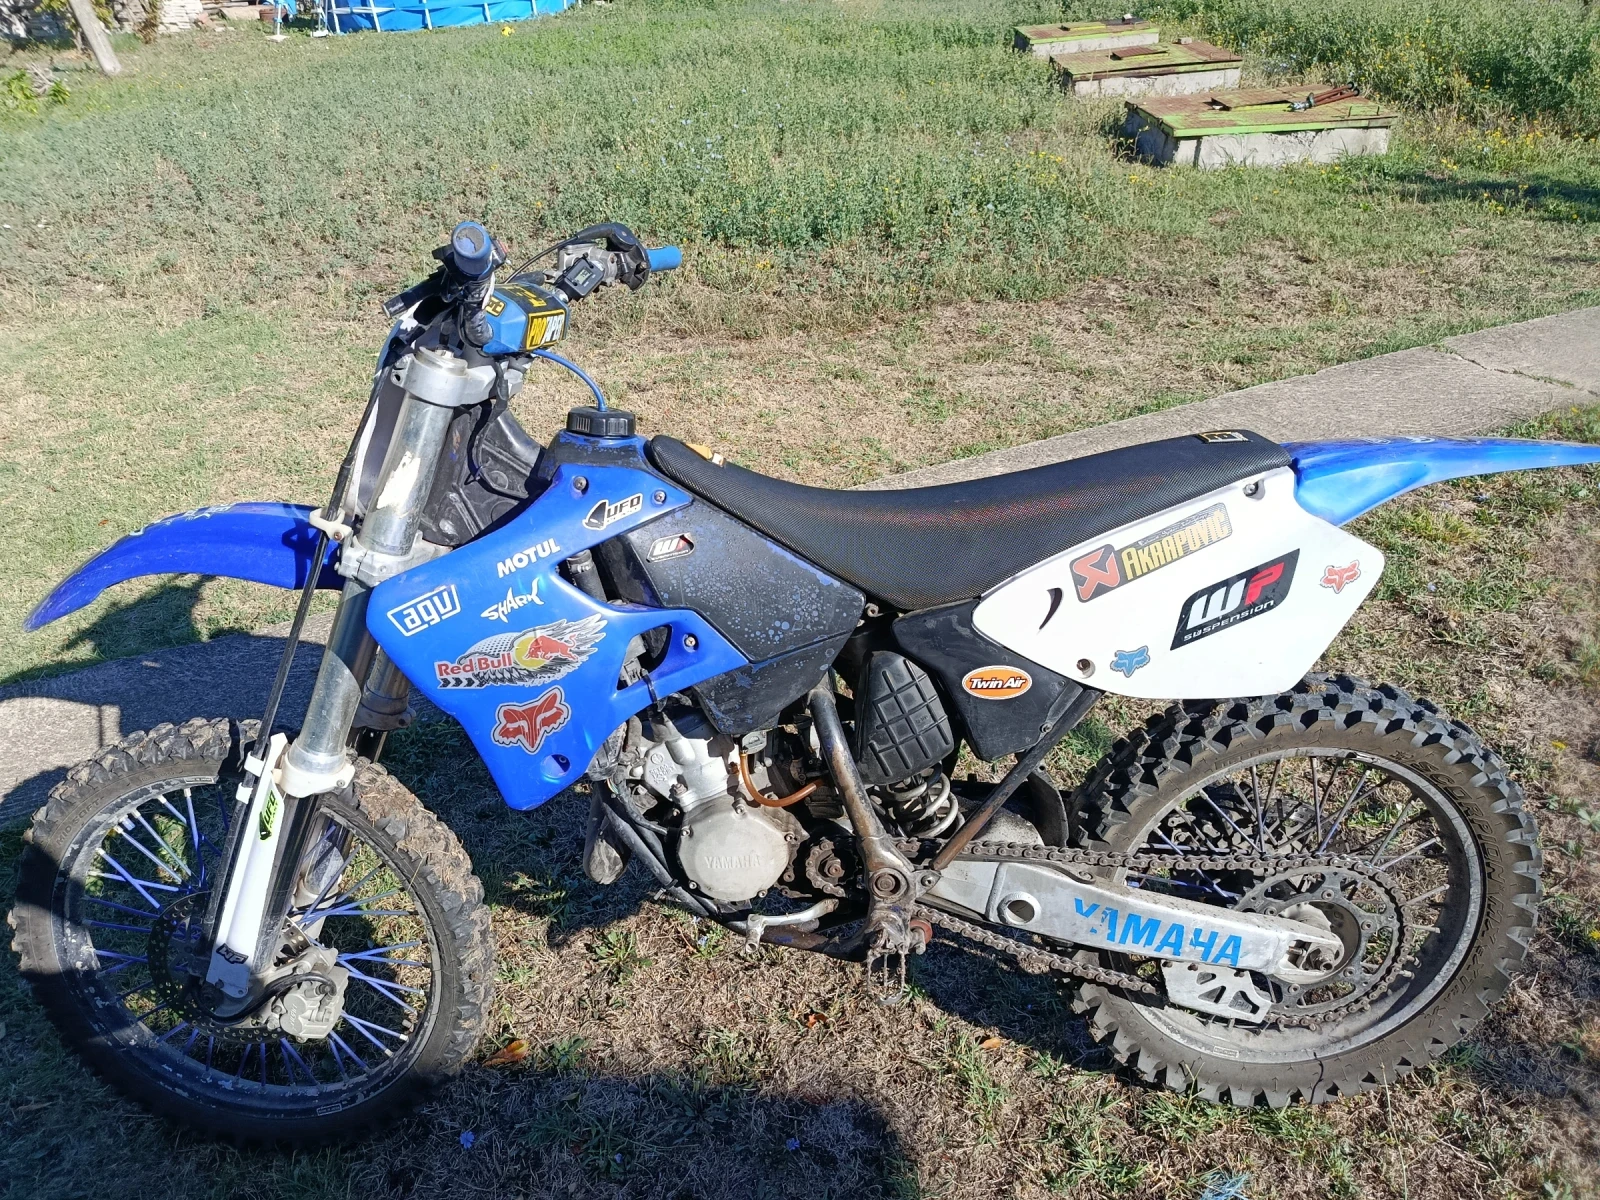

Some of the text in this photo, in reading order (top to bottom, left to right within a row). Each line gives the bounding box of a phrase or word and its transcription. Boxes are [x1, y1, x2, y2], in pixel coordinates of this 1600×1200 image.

[606, 495, 641, 518] UFO
[496, 537, 561, 579] MOTUL
[402, 590, 452, 626] agv
[480, 577, 545, 624] SHARK
[1186, 561, 1285, 630] WP
[1183, 599, 1275, 642] SUSPENSION
[437, 652, 513, 677] Red Bull
[970, 676, 1027, 689] Twin Air
[264, 789, 276, 826] UFO
[1410, 761, 1506, 883] SCORPION
[704, 853, 761, 869] YAMAHA
[1074, 897, 1243, 967] YAMAHA
